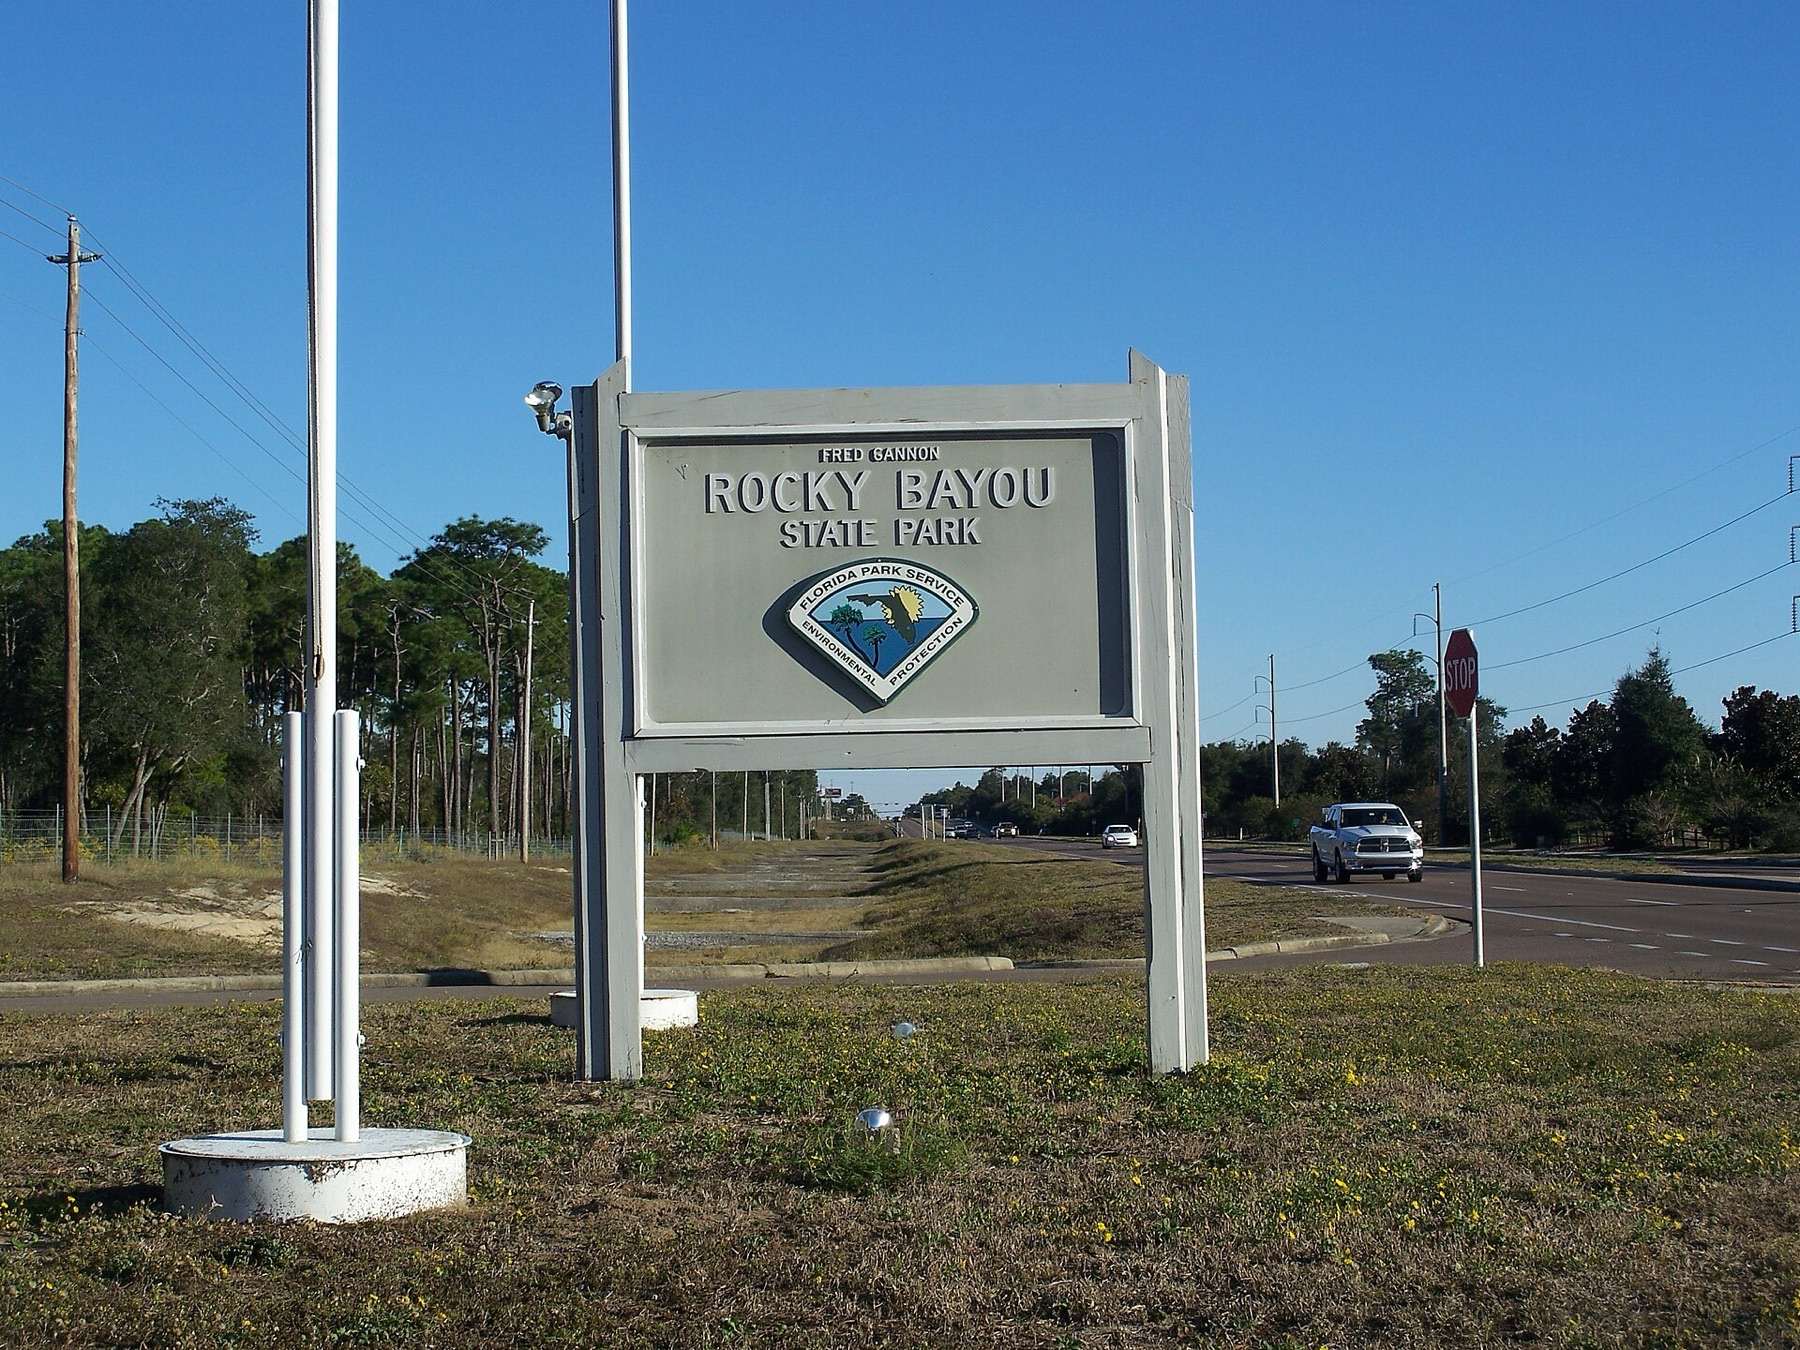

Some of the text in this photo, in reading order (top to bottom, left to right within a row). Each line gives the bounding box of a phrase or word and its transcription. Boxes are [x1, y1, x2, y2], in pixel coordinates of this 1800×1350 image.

[820, 446, 940, 462] FRED GANNON
[705, 466, 1055, 513] ROCKY BAYOU
[779, 517, 981, 548] STATE PARK
[800, 565, 965, 610] FLORIDA PARK SERVICE
[802, 620, 876, 687] ENVIRONMENTAL
[889, 617, 963, 686] PROTECTION
[1446, 657, 1476, 692] STOP
